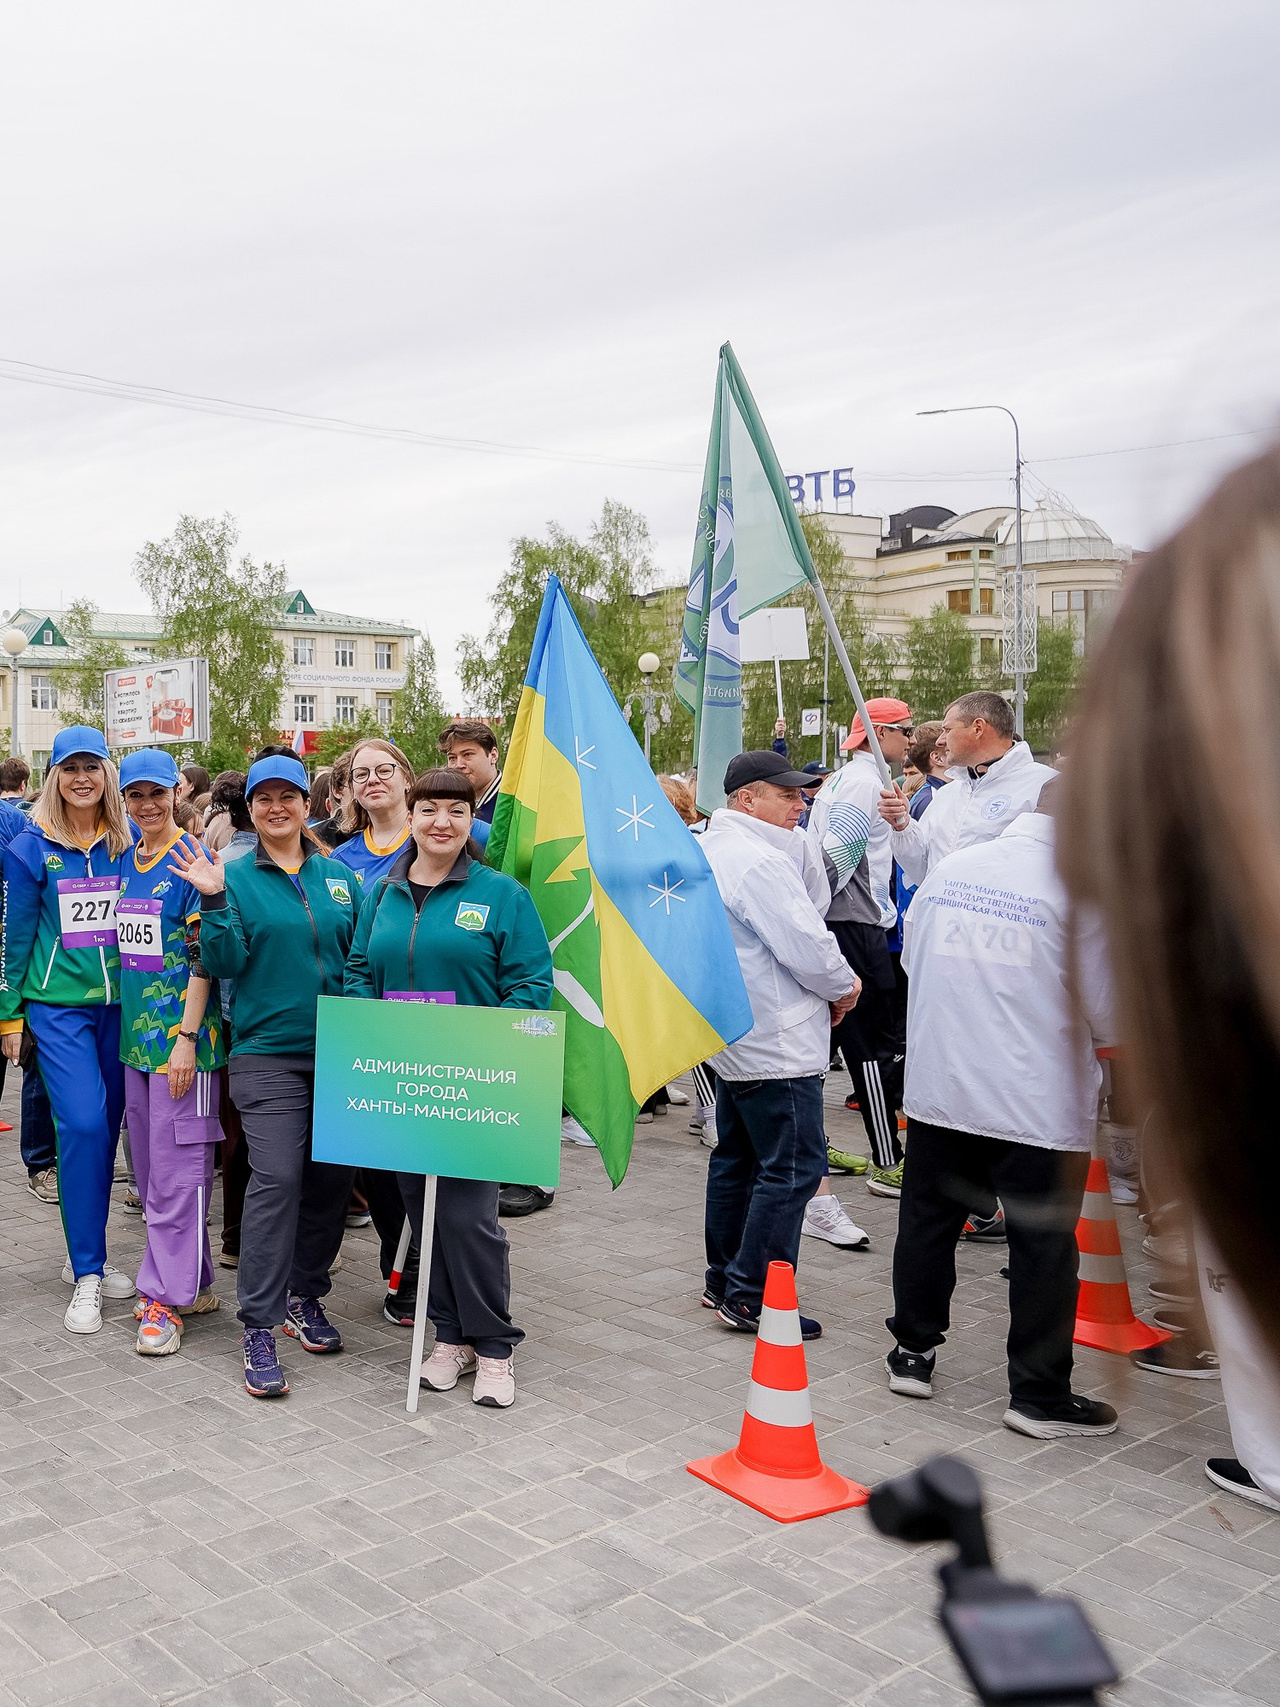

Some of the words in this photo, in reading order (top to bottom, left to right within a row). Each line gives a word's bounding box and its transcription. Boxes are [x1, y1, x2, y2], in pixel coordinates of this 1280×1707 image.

[785, 467, 855, 502] ВТБ
[303, 674, 350, 682] СОЦИАЛЬНОГО
[928, 896, 991, 915] МЕДИЦИНСКАЯ
[992, 910, 1047, 928] АКАДЕМИЯ
[943, 888, 1030, 914] ГОСУДАРСТВЕННАЯ
[118, 922, 153, 945] 2065
[944, 919, 1019, 952] 270
[351, 1057, 517, 1084] АДМИНИСТРАЦИЯ
[396, 1082, 469, 1101] ГОРОДА
[346, 1097, 521, 1126] ХАНТЫ-МАНСИЙСК
